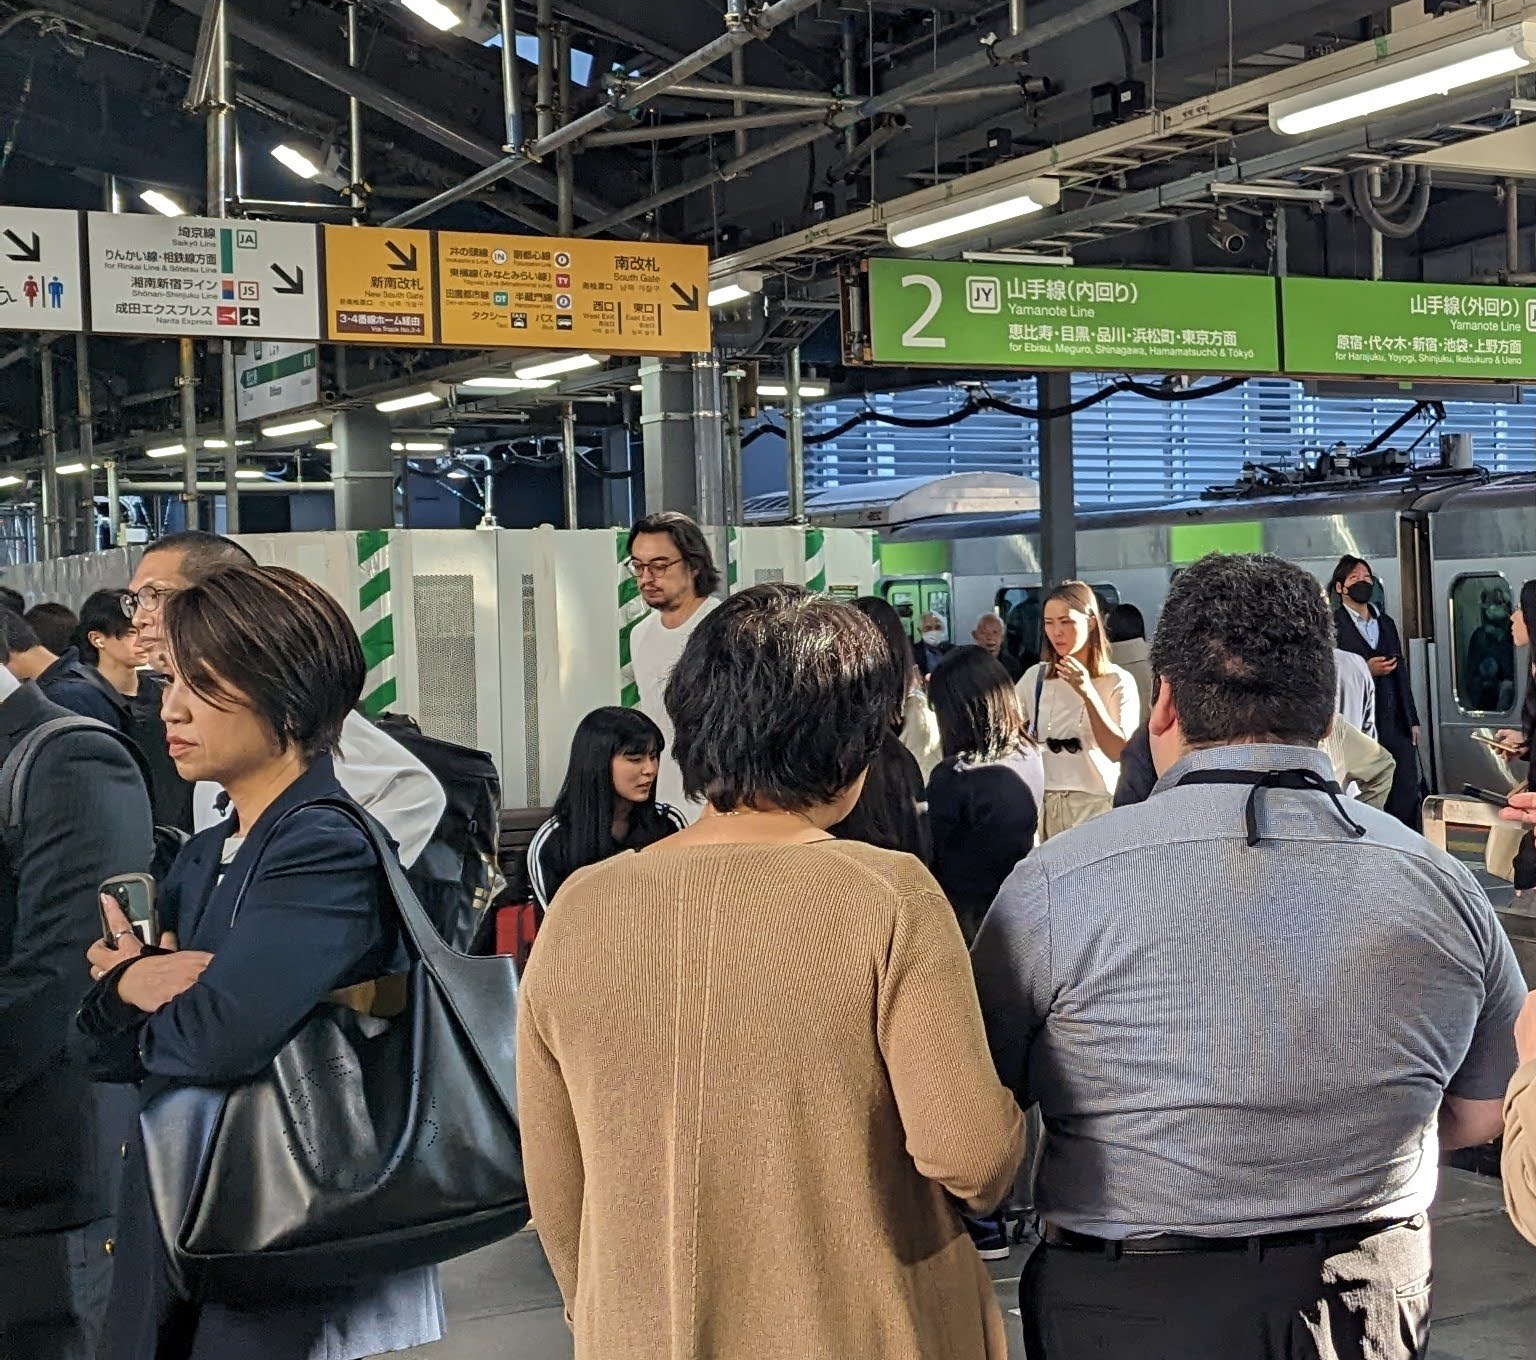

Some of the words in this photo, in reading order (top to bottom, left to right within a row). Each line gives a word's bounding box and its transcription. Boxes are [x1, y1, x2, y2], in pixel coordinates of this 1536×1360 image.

[178, 226, 216, 239] 埼京線
[239, 234, 255, 244] JA
[105, 249, 217, 265] りんかい線・相鉄線方面
[614, 255, 660, 272] 南改札
[104, 262, 115, 270] for
[117, 262, 141, 271] Rinkai
[143, 263, 160, 271] Line
[162, 264, 168, 272] &
[201, 265, 217, 273] Line
[131, 276, 218, 290] 湘南新宿ライン
[370, 276, 424, 290] 新南改札
[613, 272, 639, 282] South
[640, 274, 661, 283] Gate
[201, 292, 218, 300] Line
[242, 286, 256, 296] JS
[383, 291, 405, 299] South
[406, 292, 424, 300] Gate
[973, 287, 993, 302] JY
[1006, 277, 1138, 304] 山手線(内回り)
[495, 295, 507, 303] DT
[115, 302, 213, 316] 成田エクスプレス
[592, 300, 614, 312] 西口
[633, 303, 655, 313] 東口
[901, 274, 946, 348] 2
[1007, 303, 1067, 317] Yamanote
[1070, 305, 1095, 318] Line
[1410, 294, 1520, 318] 山手線(外回り)
[156, 317, 180, 325] Narita
[182, 317, 213, 326] Express
[471, 311, 508, 321] タクシー
[535, 313, 553, 323] バス
[1450, 319, 1498, 332] Yamanote
[1500, 320, 1521, 332] Line
[1008, 323, 1237, 347] 恵比寿・目黒・品川・浜松町・東京方面
[1009, 342, 1022, 352] for
[1024, 343, 1053, 354] Ebisu,
[1055, 344, 1094, 356] Meguro,
[1095, 345, 1147, 357] Shinagawa,
[1219, 348, 1226, 357] &
[1336, 334, 1522, 354] 原宿・代々木・新宿・池袋・上野方面
[1335, 352, 1347, 361] for
[1348, 352, 1386, 363] Harajuku,
[1388, 353, 1417, 364] Yoyogi,
[1418, 354, 1454, 365] Shinjuku,
[1456, 355, 1494, 365] Ikebukuro
[1494, 356, 1500, 365] &
[1502, 356, 1522, 365] Ueno
